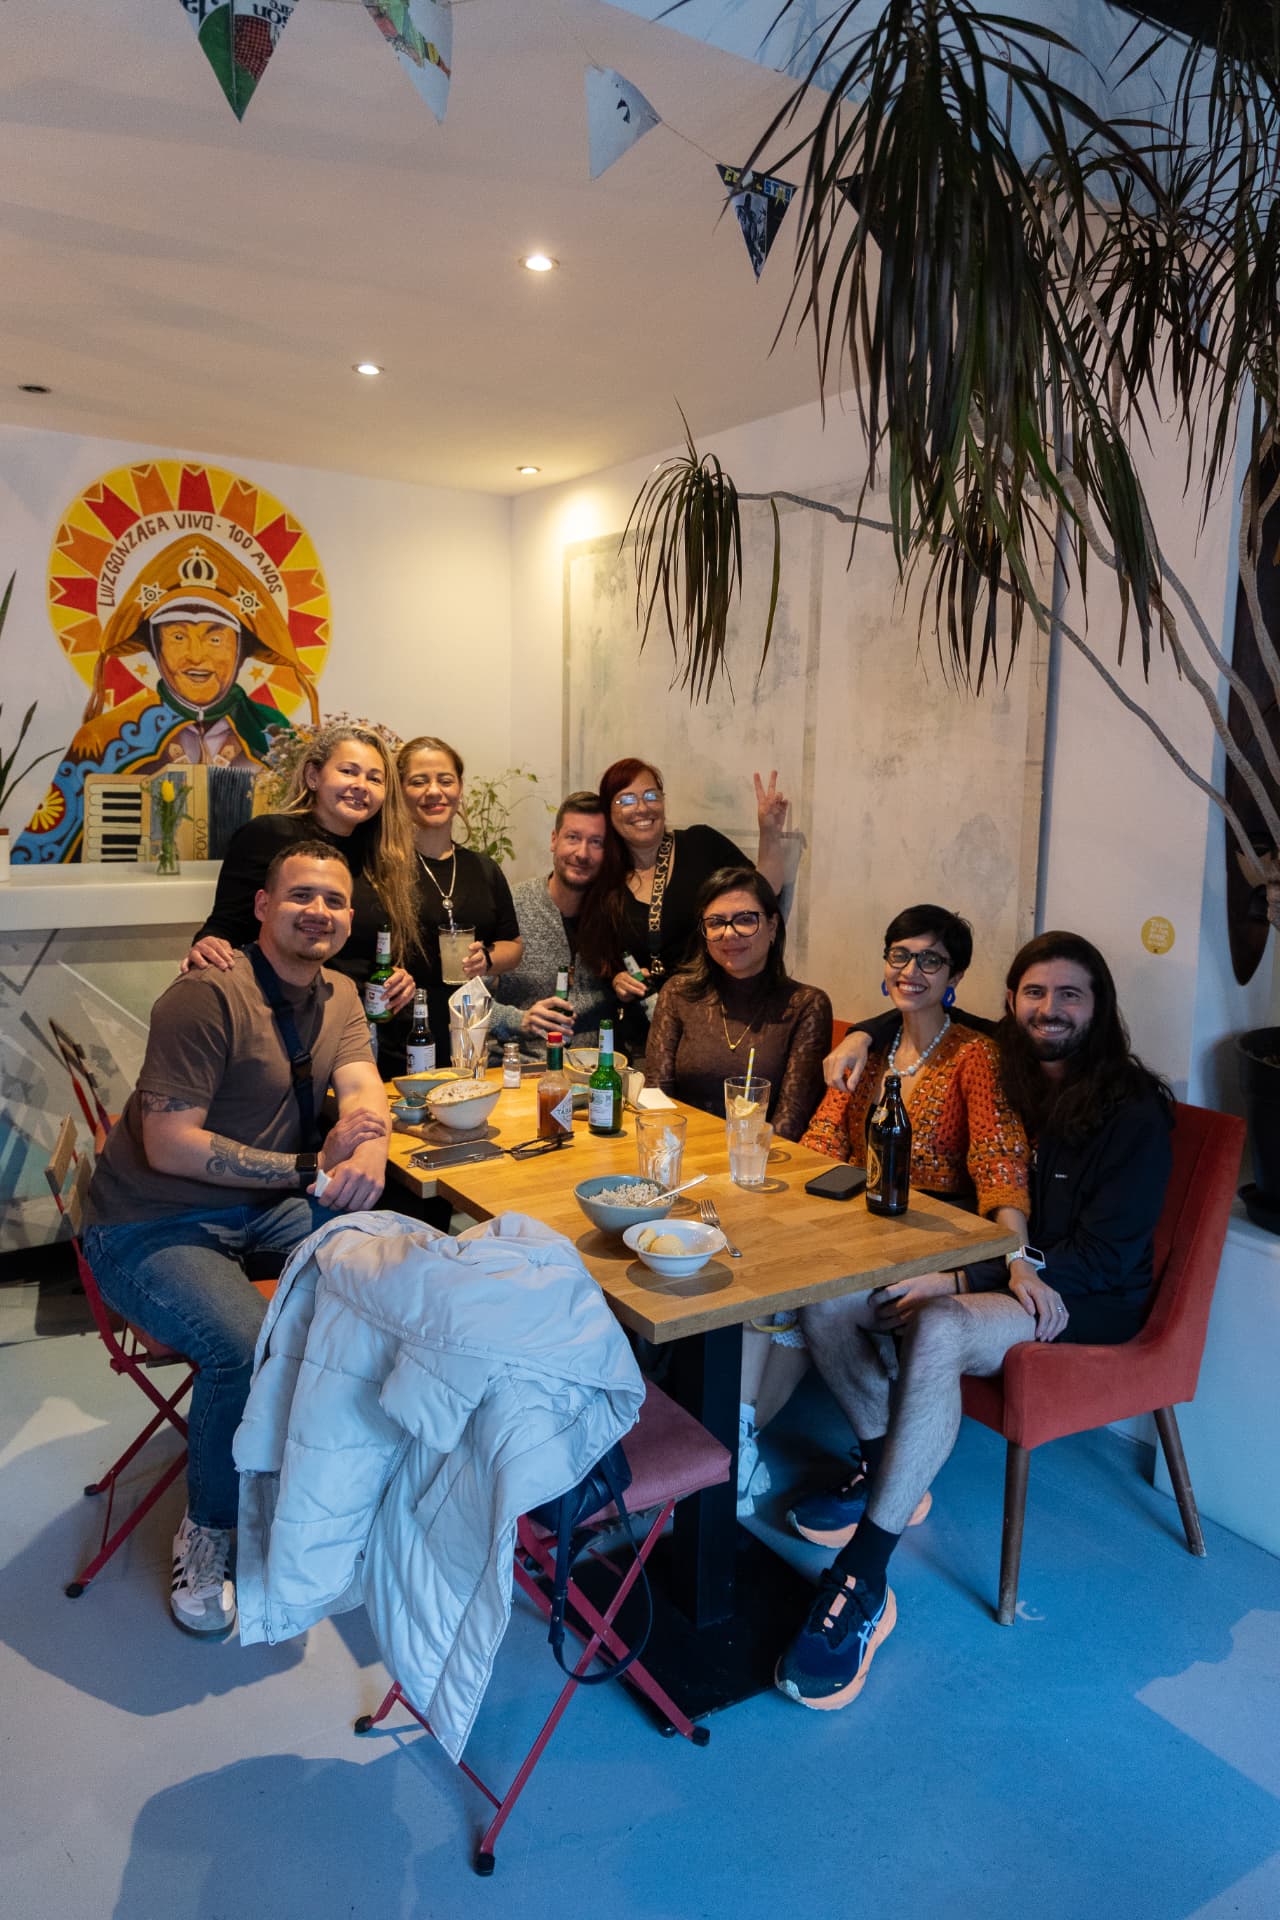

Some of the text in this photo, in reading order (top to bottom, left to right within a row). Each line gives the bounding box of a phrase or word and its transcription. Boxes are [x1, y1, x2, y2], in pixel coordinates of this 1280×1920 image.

[104, 516, 171, 578] GONZAGA
[174, 513, 214, 531] VIVO
[228, 524, 254, 550] 100
[251, 551, 283, 595] ANOS
